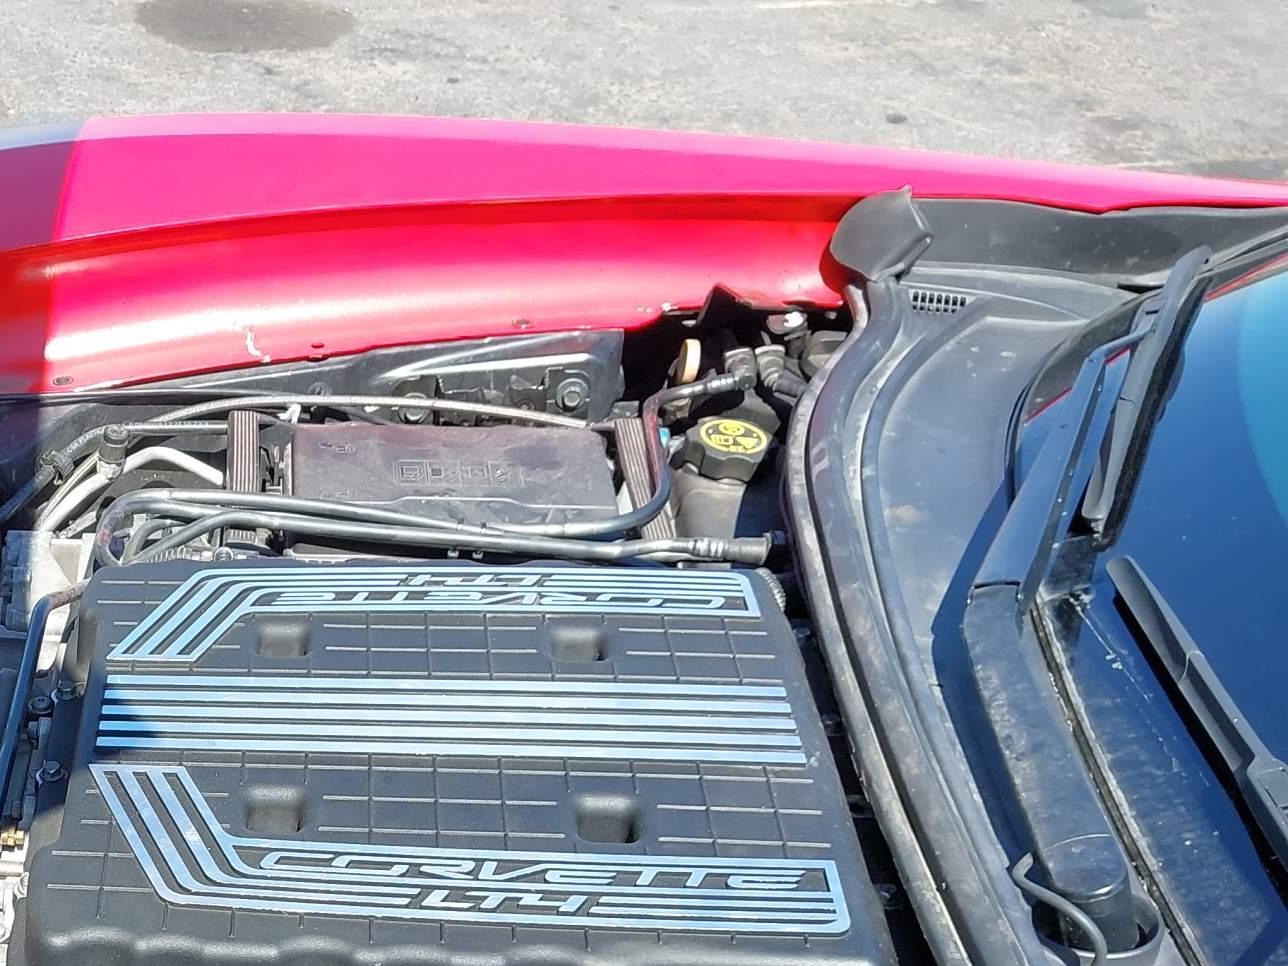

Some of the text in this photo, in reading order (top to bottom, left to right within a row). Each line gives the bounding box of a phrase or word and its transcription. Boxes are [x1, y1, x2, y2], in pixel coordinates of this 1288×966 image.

[410, 573, 546, 588] LT4
[276, 589, 726, 610] CORVETTE
[258, 851, 808, 890] CORVETTE
[420, 888, 590, 914] LT4
